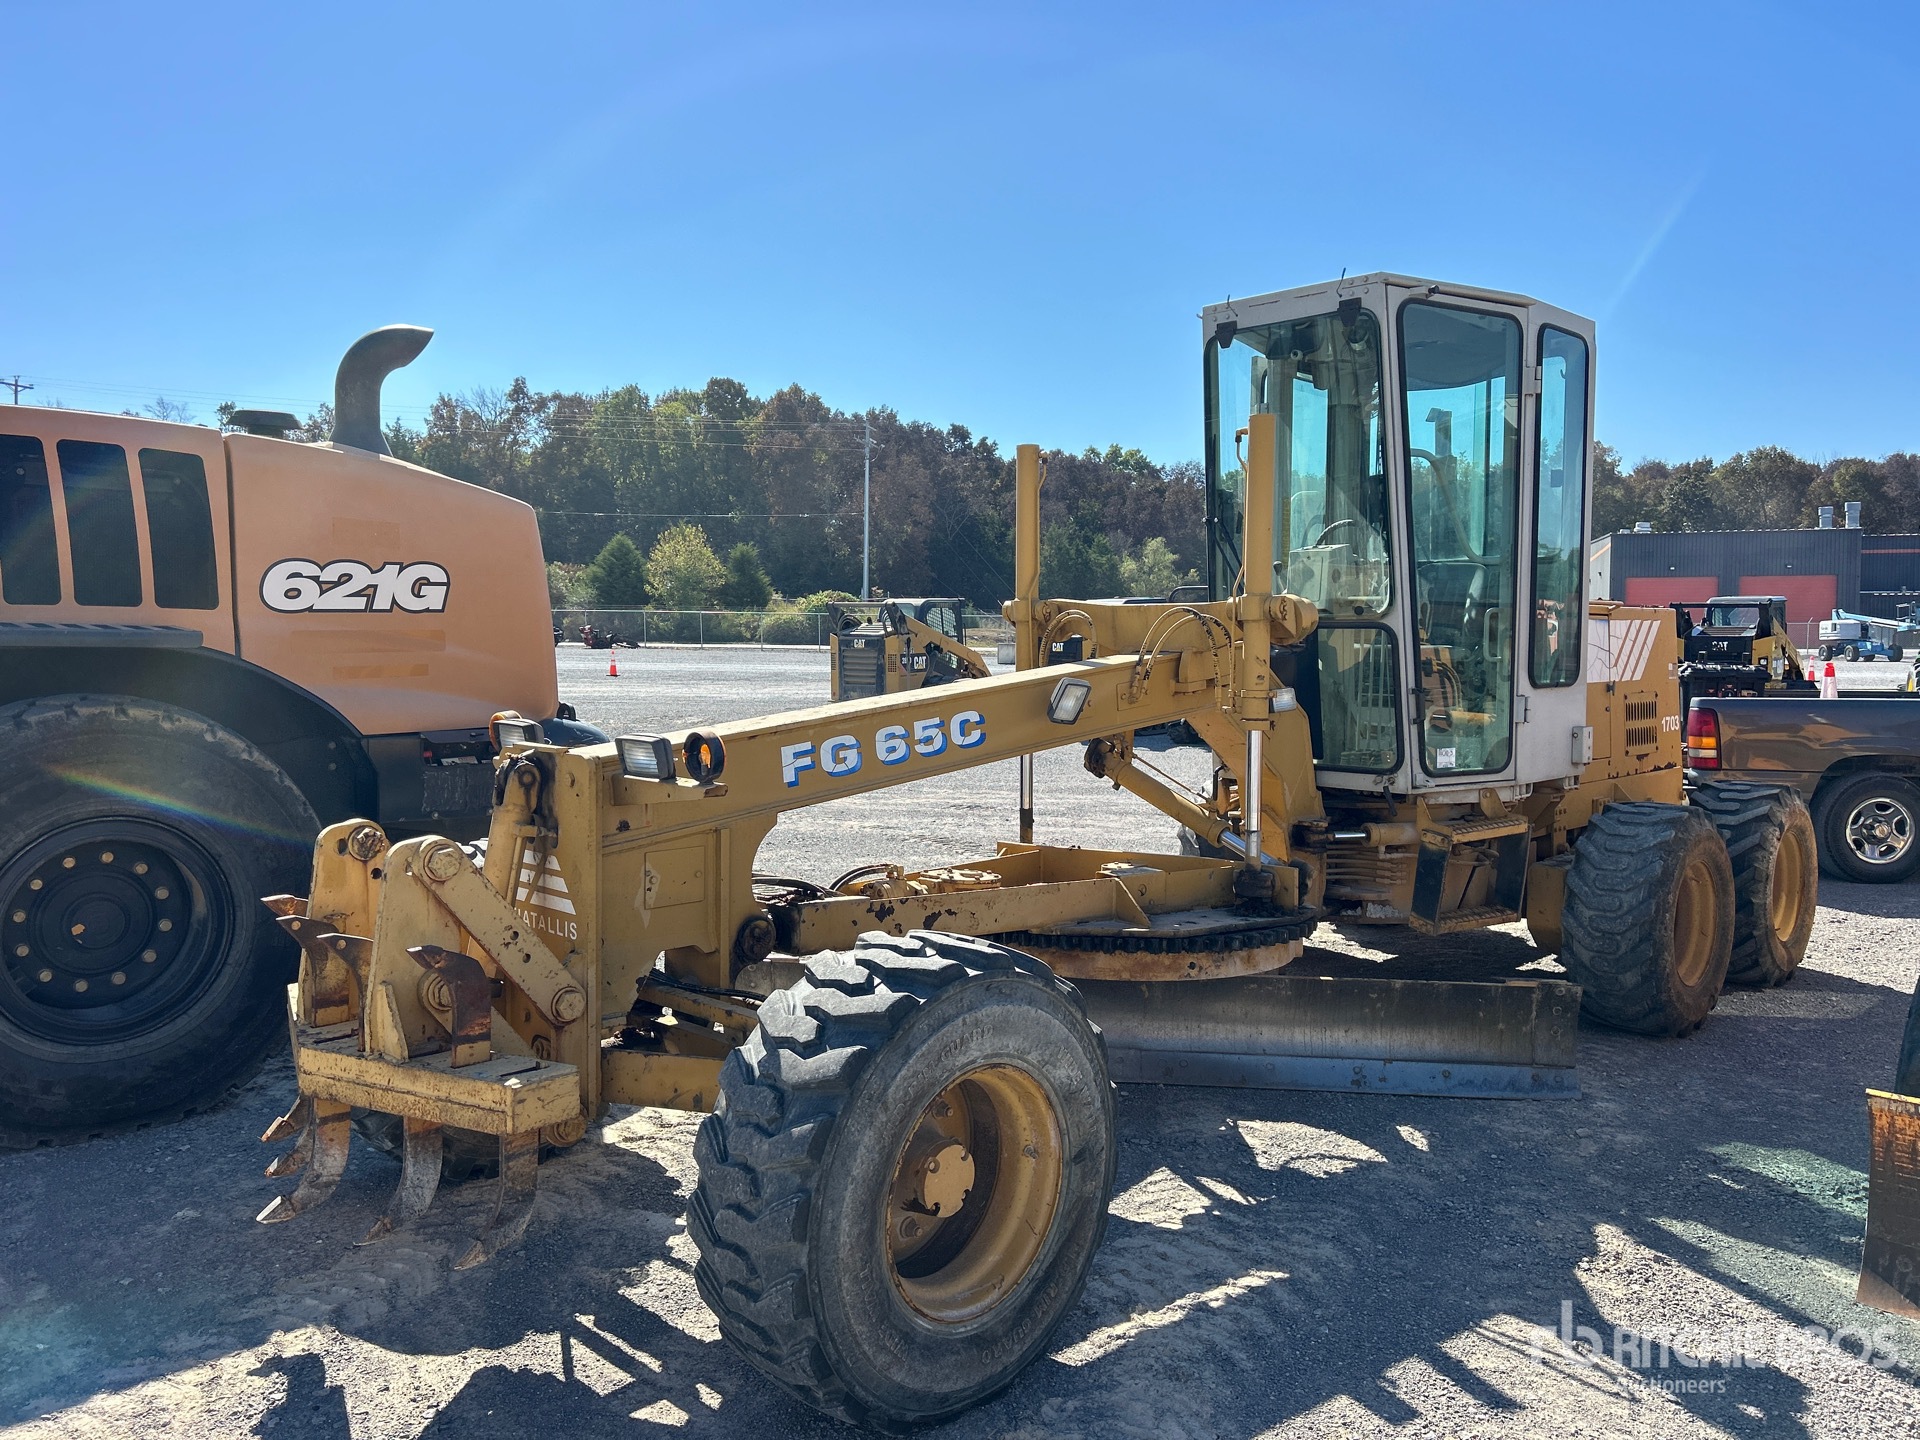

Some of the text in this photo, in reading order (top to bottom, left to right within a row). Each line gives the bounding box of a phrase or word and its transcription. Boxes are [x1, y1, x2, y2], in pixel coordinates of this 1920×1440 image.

[259, 557, 451, 613] 621G
[853, 638, 866, 649] CAT
[1052, 642, 1064, 652] CAT
[913, 656, 927, 669] CAT
[1661, 715, 1680, 732] 1703
[780, 710, 987, 788] FG 65C
[514, 907, 578, 940] ATALLIS
